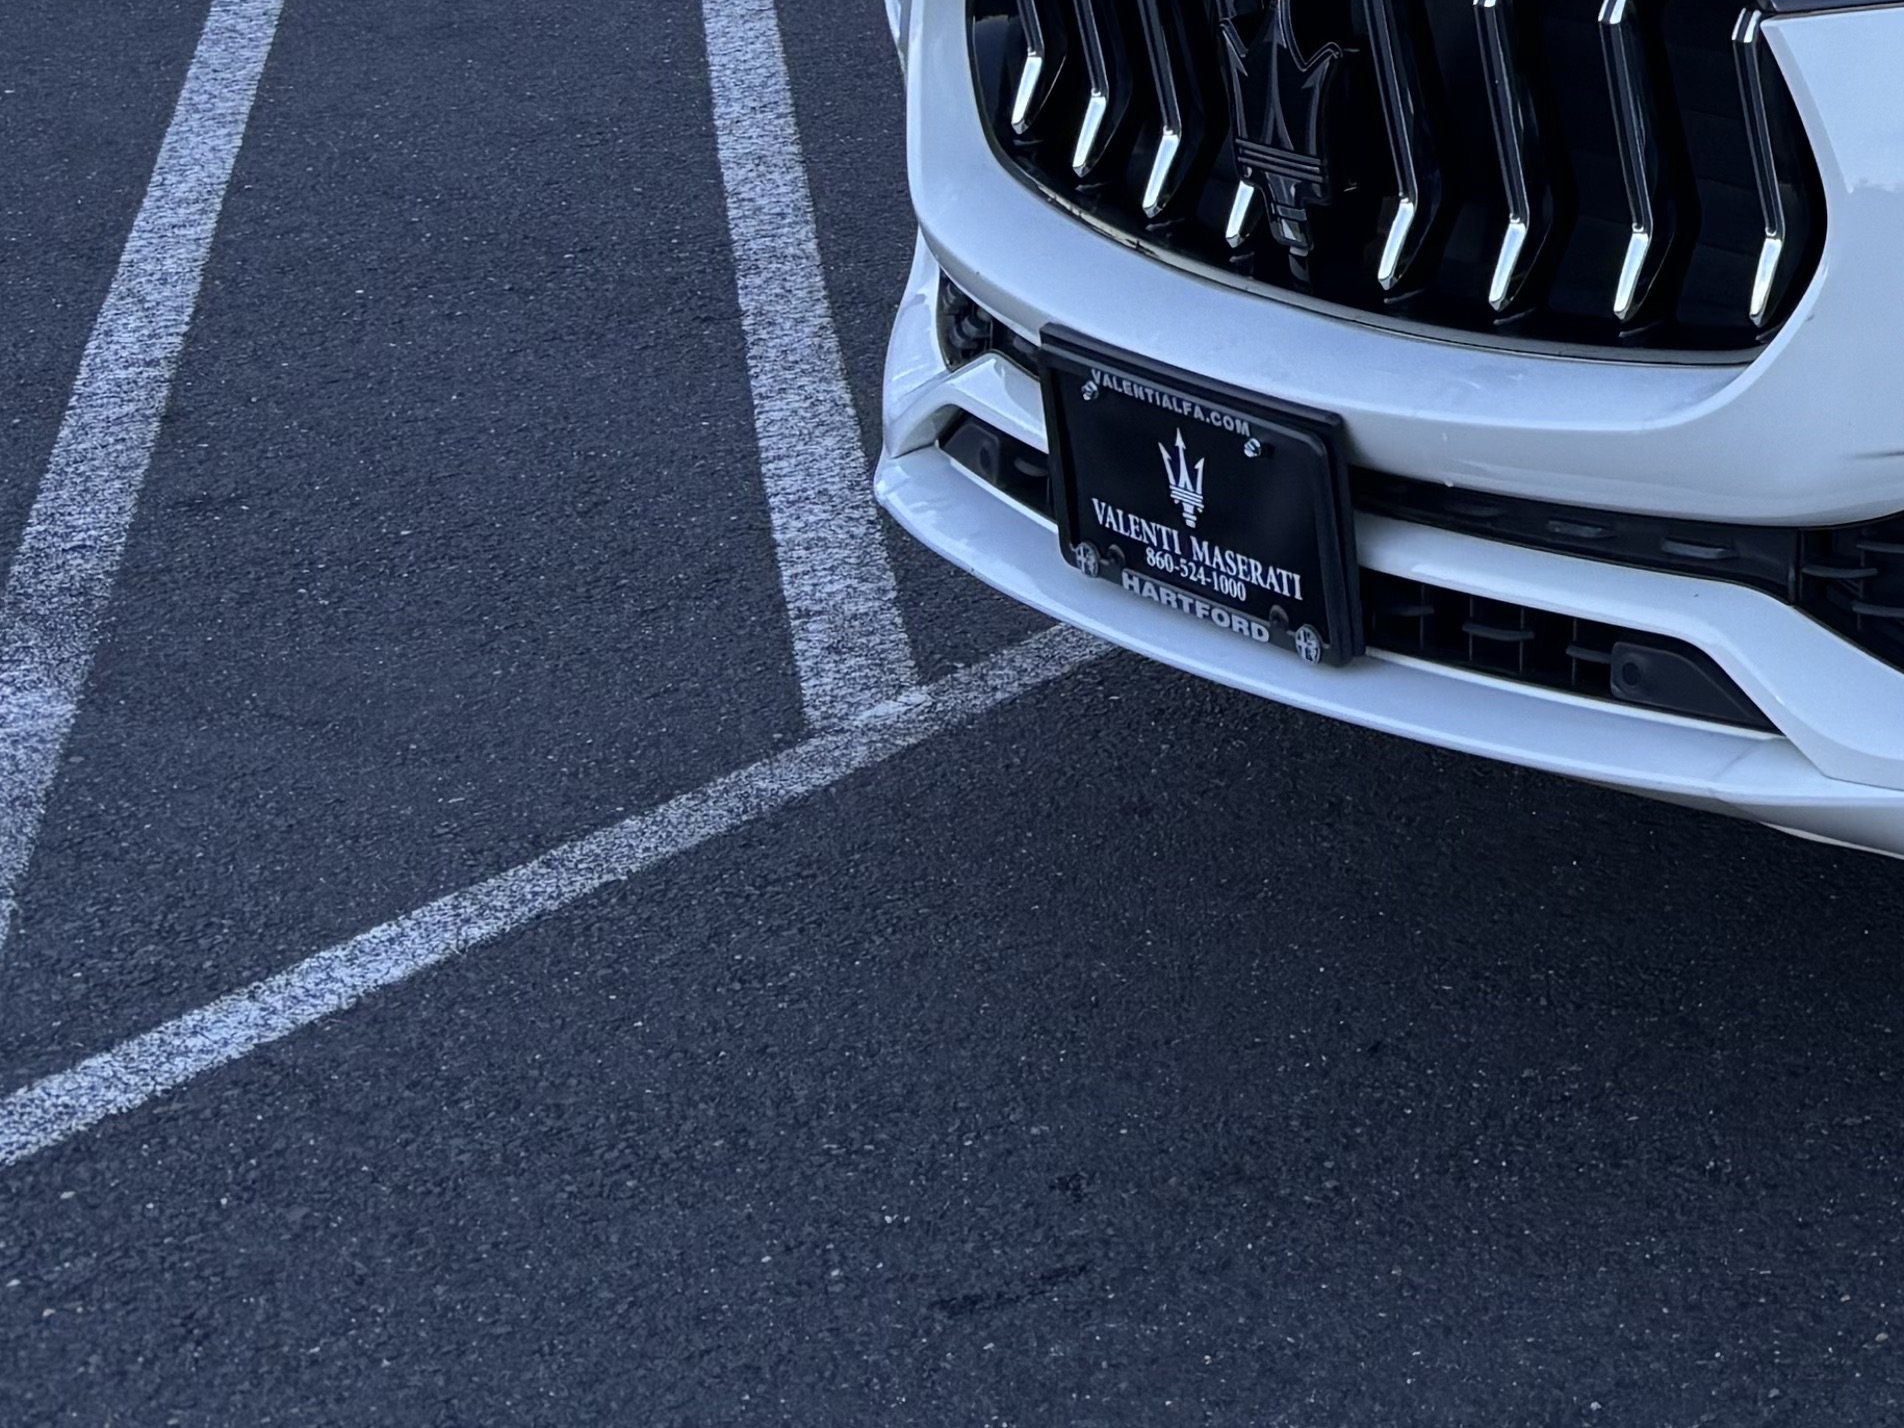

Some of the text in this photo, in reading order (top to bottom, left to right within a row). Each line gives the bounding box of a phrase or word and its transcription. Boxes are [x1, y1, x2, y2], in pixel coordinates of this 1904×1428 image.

[1091, 368, 1251, 437] VALENTIALFA.COM
[1091, 497, 1304, 601] VALENTI MASERATI
[1145, 547, 1247, 602] 860-524-1000
[1121, 570, 1271, 644] HARTFORD
